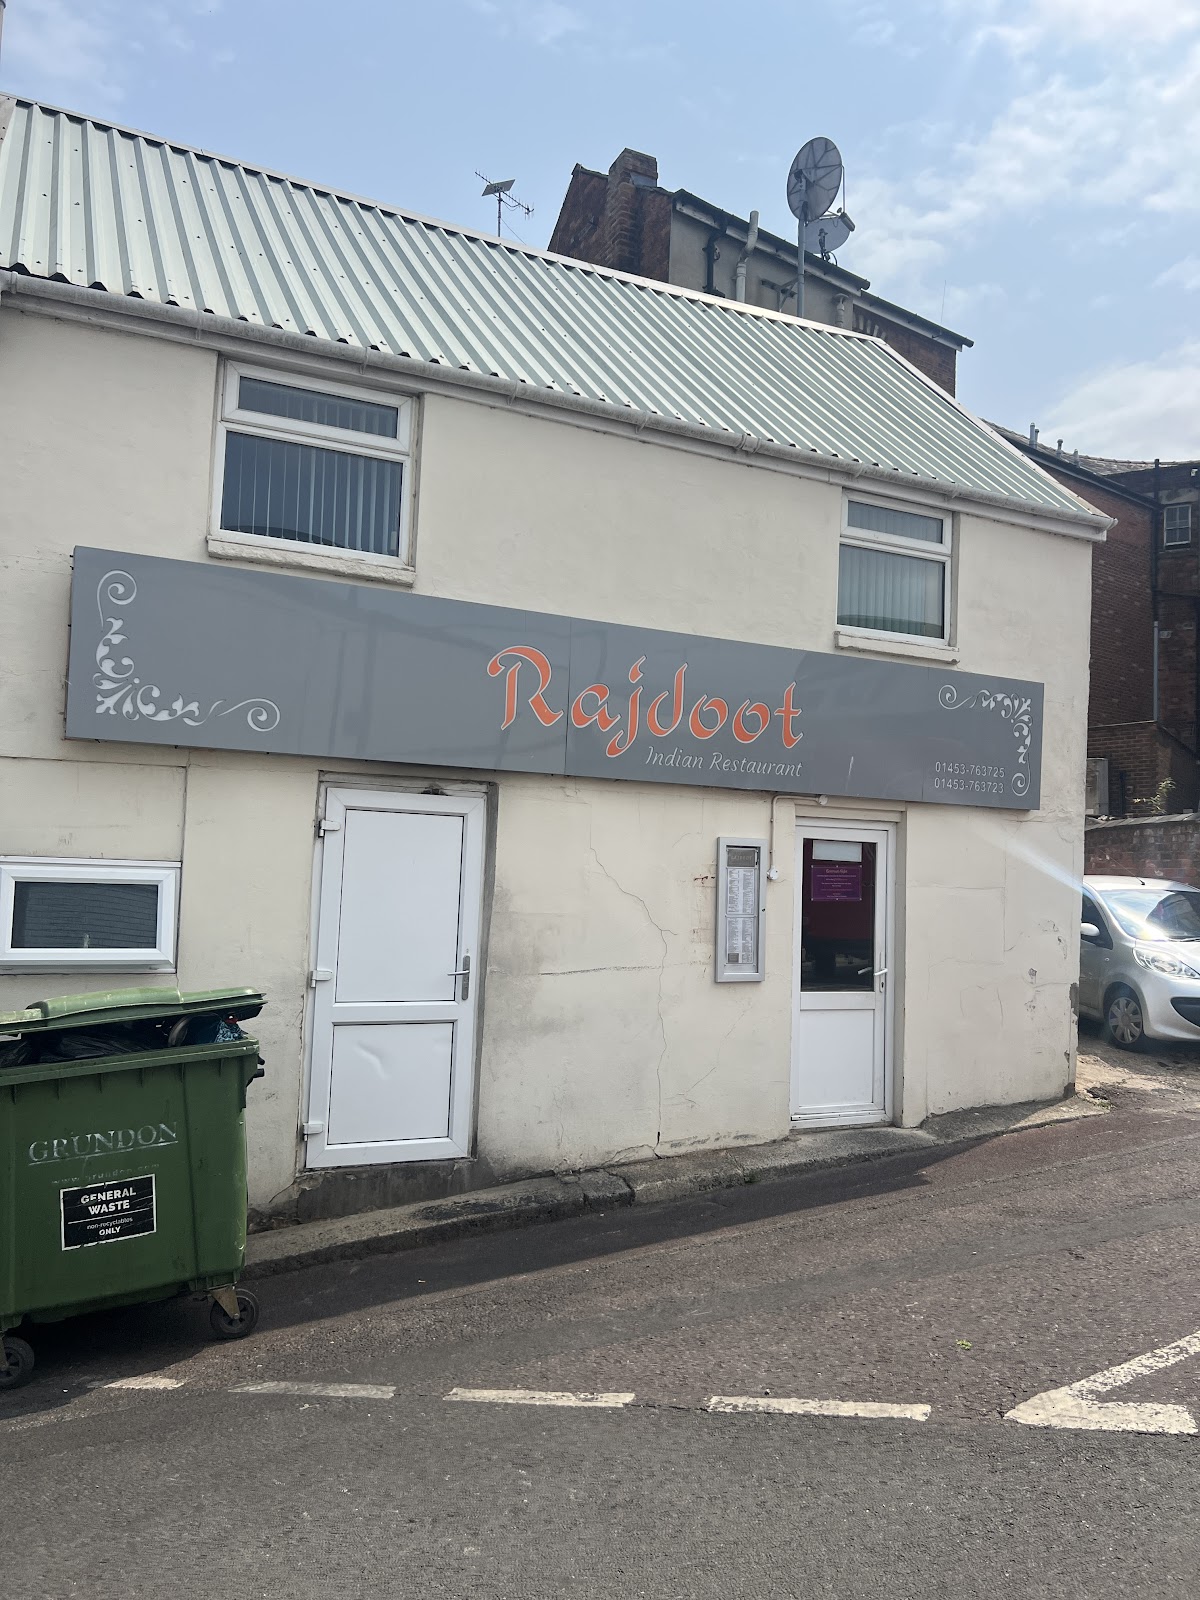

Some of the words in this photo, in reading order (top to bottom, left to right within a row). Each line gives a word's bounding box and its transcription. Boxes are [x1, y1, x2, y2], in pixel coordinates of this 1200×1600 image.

[487, 645, 804, 758] Rajdoot
[645, 746, 704, 769] Indian
[709, 752, 803, 777] Restaurant
[935, 761, 1005, 778] 01453-763725
[934, 777, 1004, 793] 01453-763723
[29, 1121, 177, 1162] GRUNDON
[80, 1186, 136, 1205] GENERAL
[88, 1200, 130, 1215] WASTE
[86, 1216, 133, 1230] non-recyclables
[99, 1226, 121, 1236] ONLY
